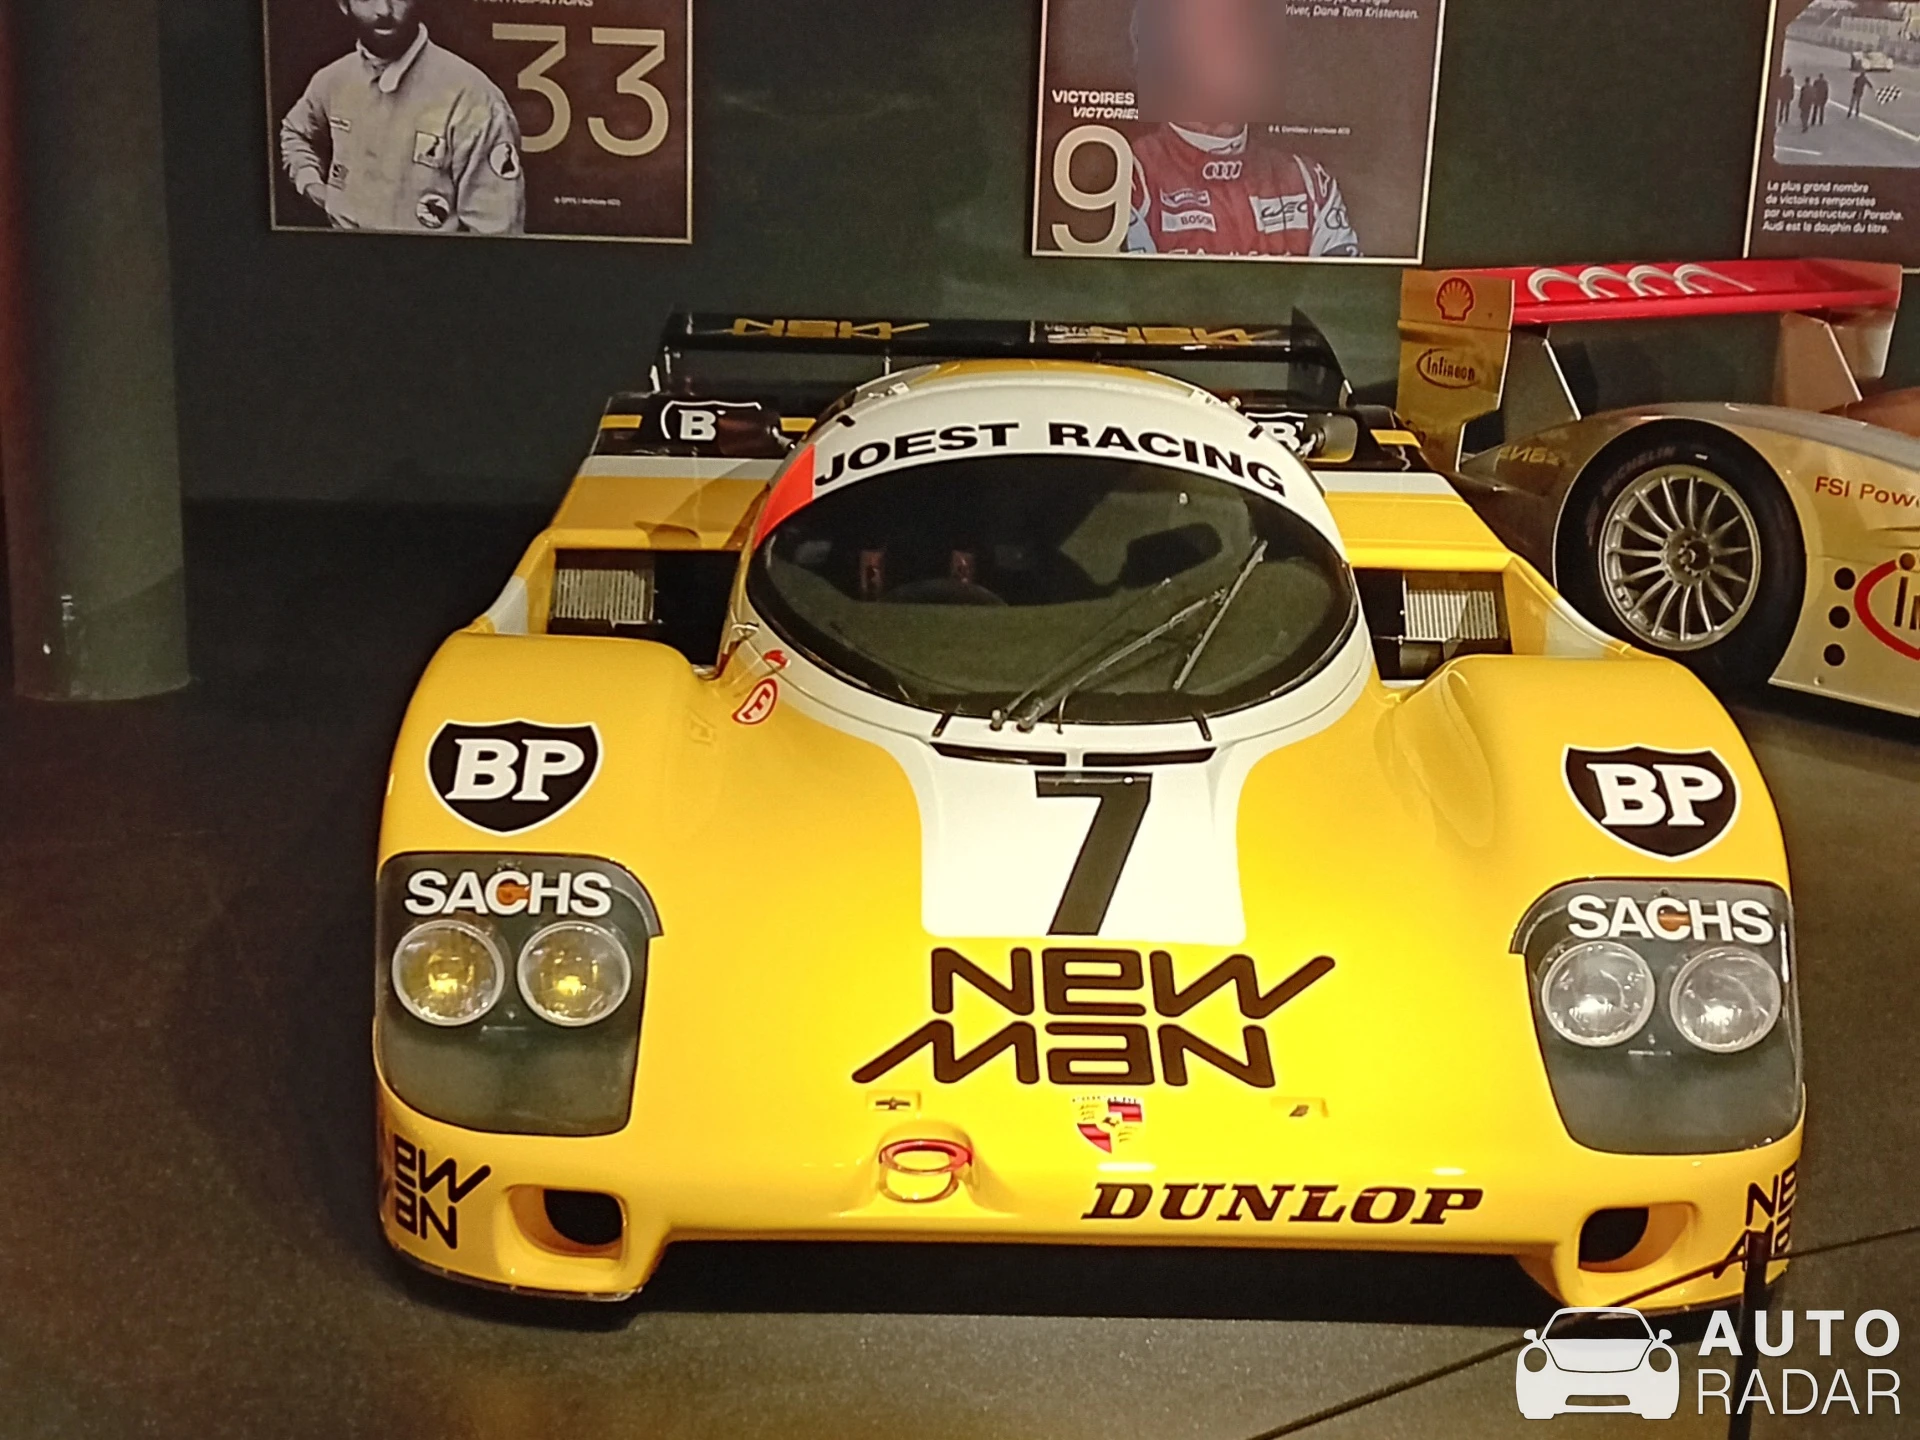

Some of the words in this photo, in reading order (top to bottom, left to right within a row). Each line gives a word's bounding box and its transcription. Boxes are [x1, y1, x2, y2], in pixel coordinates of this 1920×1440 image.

[1286, 4, 1310, 18] river,
[1313, 4, 1340, 16] Dane
[1343, 6, 1363, 17] Tom
[1365, 6, 1419, 19] Kristensen.
[492, 22, 670, 157] 33
[1052, 89, 1135, 105] VICTOIRES
[1051, 124, 1134, 256] 9
[1765, 194, 1778, 204] de
[1780, 194, 1820, 205] victoires
[1822, 196, 1876, 207] remportées
[1767, 180, 1779, 191] Le
[1781, 180, 1801, 193] plus
[1803, 182, 1831, 194] grand
[1833, 182, 1869, 193] nombre
[1763, 221, 1785, 232] Audi
[1786, 222, 1801, 232] est
[1814, 222, 1852, 234] dauphin
[1853, 223, 1866, 232] du
[1764, 209, 1780, 219] par
[1782, 209, 1795, 218] un
[1796, 209, 1857, 219] constructeur
[678, 409, 726, 441] B
[1258, 421, 1304, 452] B
[815, 423, 1020, 487] JOEST
[1048, 422, 1287, 497] RACING
[1815, 475, 1851, 498] FSI
[1859, 483, 1920, 508] Pow
[445, 738, 585, 802] BP
[1586, 763, 1724, 827] BP
[1034, 769, 1154, 937] 7
[404, 870, 613, 917] SACHS
[1567, 894, 1774, 944] SACHS
[1081, 1182, 1484, 1225] DUNLOP
